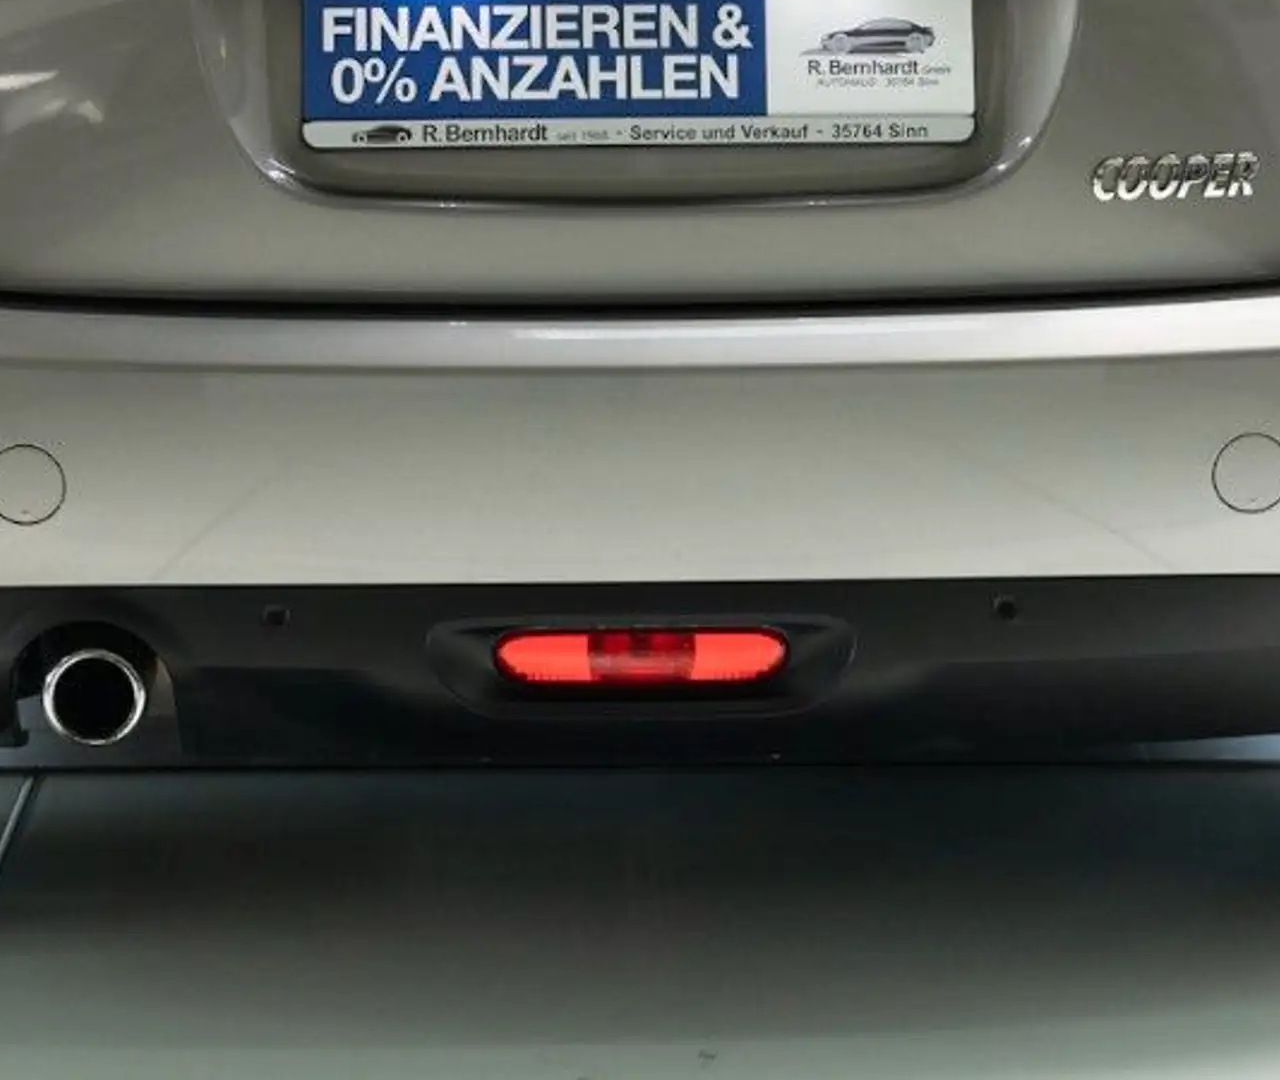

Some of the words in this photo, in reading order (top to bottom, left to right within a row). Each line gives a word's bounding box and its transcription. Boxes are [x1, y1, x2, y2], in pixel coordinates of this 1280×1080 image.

[322, 4, 699, 52] FINANZIEREN
[712, 3, 754, 50] &
[330, 56, 418, 104] 0%
[428, 54, 739, 102] ANZAHLEN
[829, 59, 919, 76] Bernhardt
[629, 124, 698, 141] Service
[702, 124, 735, 140] und
[740, 123, 808, 140] Verkauf
[831, 123, 882, 139] 35764
[888, 122, 929, 139] Sinn
[1091, 151, 1261, 202] COOPER
